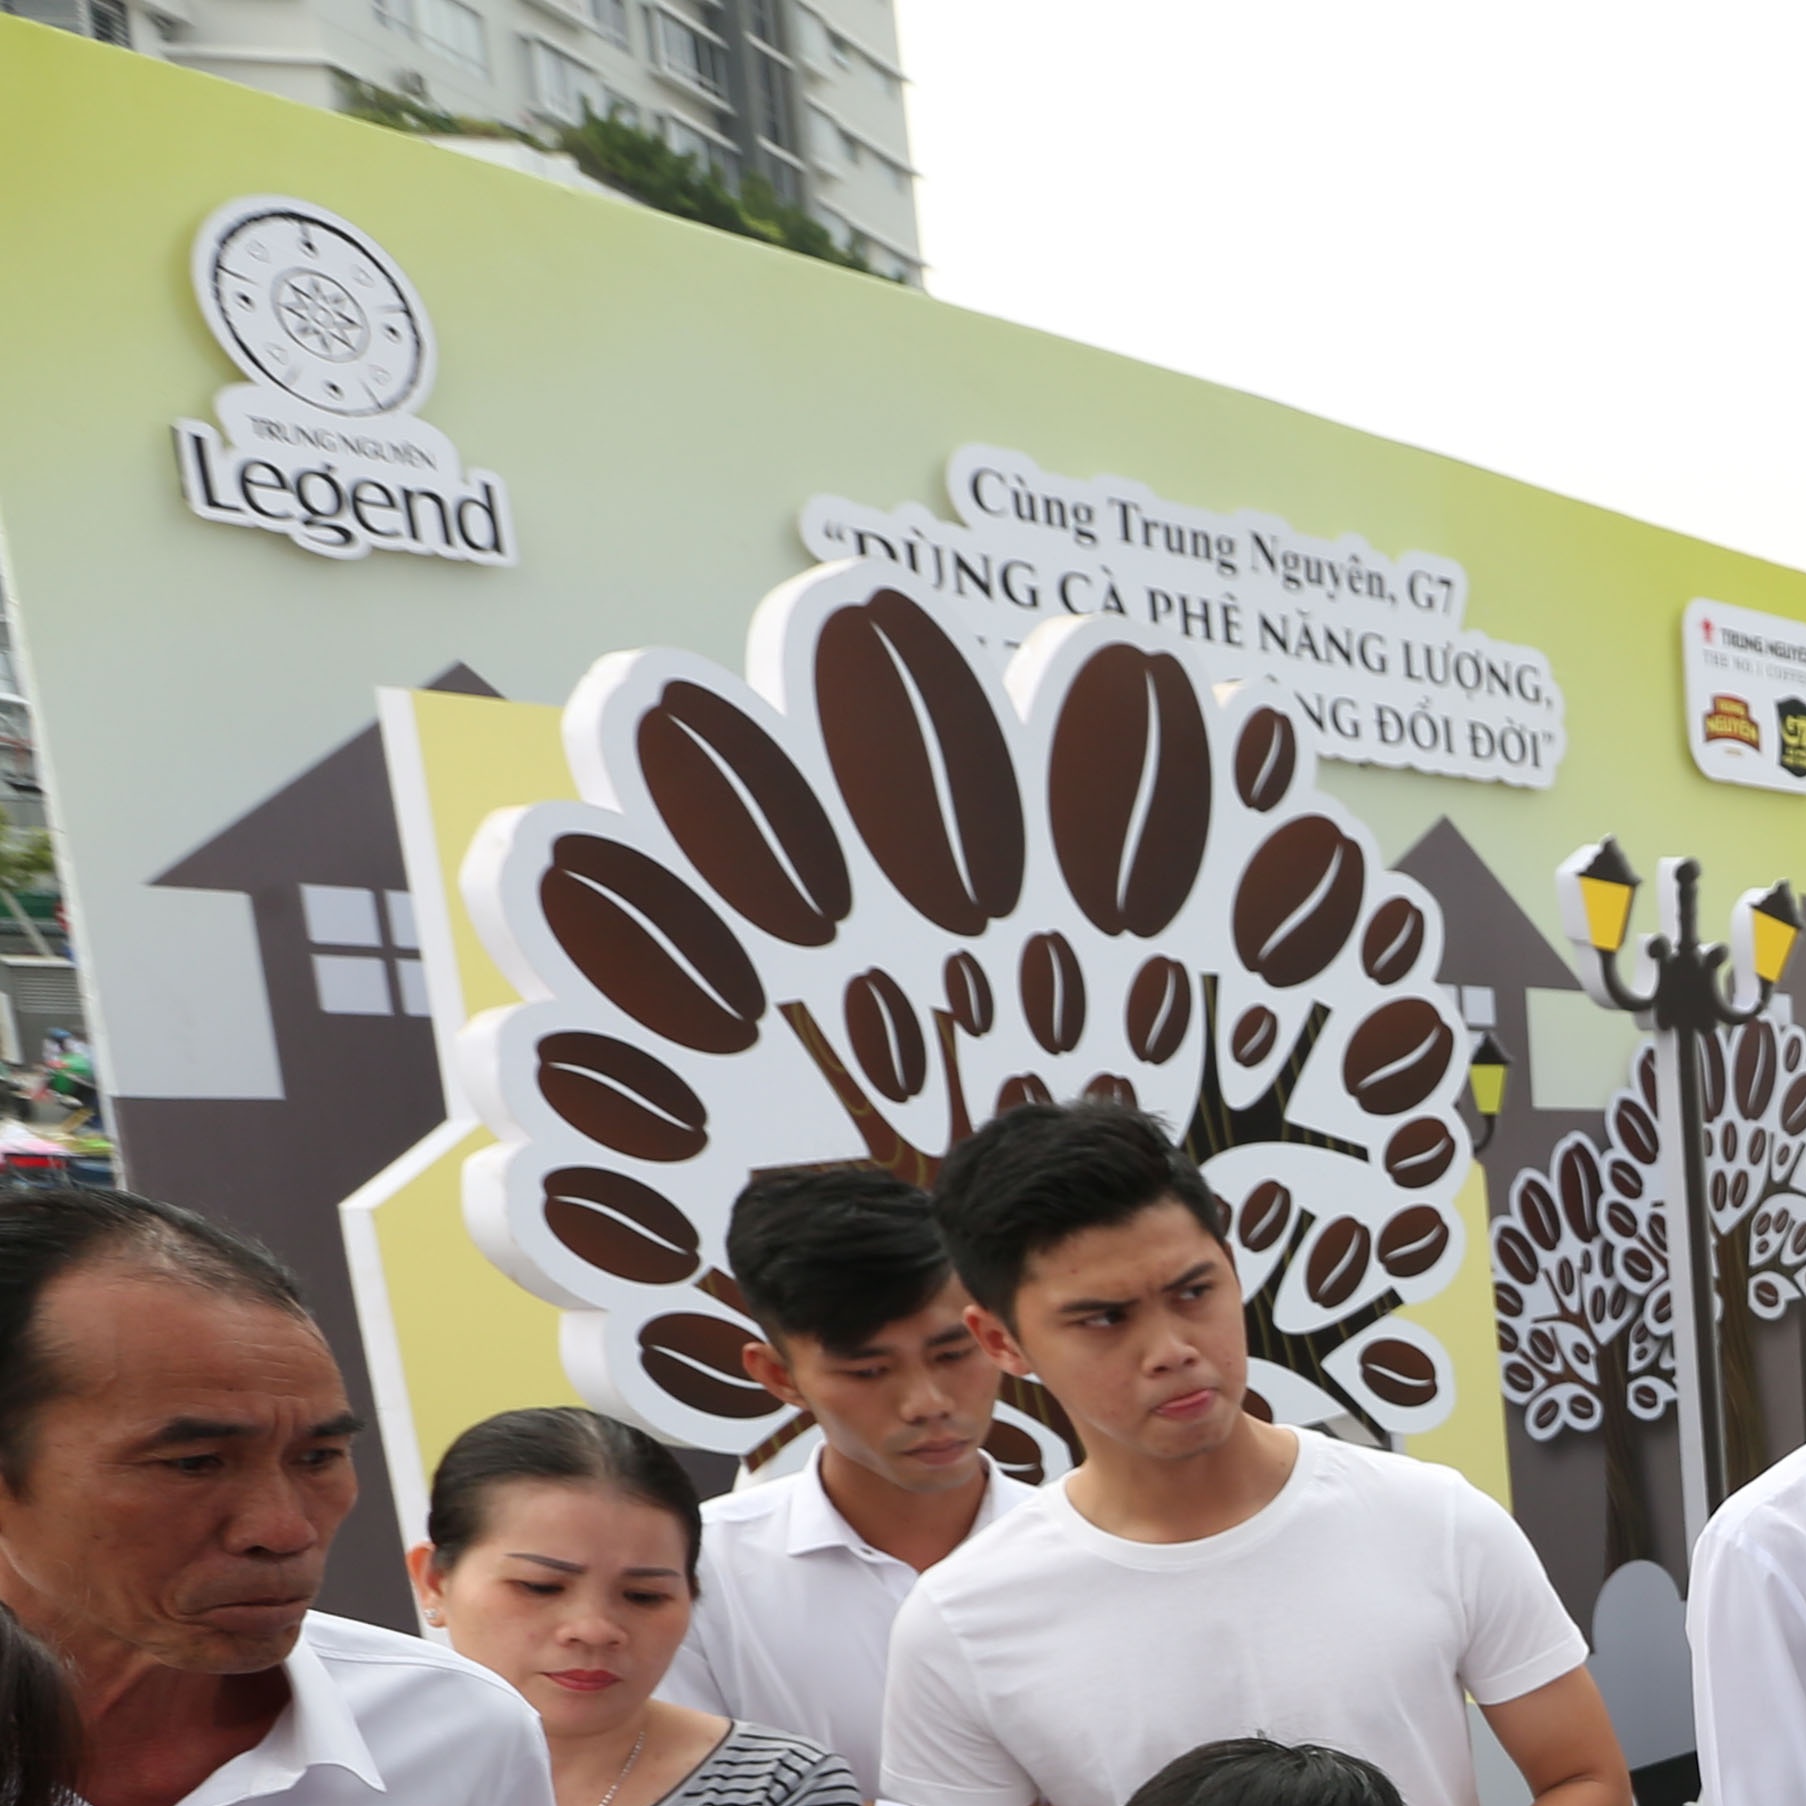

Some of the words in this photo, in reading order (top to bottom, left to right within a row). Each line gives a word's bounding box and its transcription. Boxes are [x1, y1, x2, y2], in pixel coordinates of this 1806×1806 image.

[187, 432, 508, 556] Legend
[968, 466, 1098, 549] Cùng
[1107, 495, 1238, 578] Trung
[1249, 529, 1400, 606] Nguyên,
[1407, 567, 1455, 615] G7
[1058, 564, 1128, 617] CÀ
[1145, 585, 1246, 649] PHÊ
[1257, 606, 1388, 677] NĂNG
[1401, 637, 1556, 710] LƯỢNG,
[1373, 694, 1455, 757] ĐỔI
[1466, 715, 1557, 771] ĐỜI”
